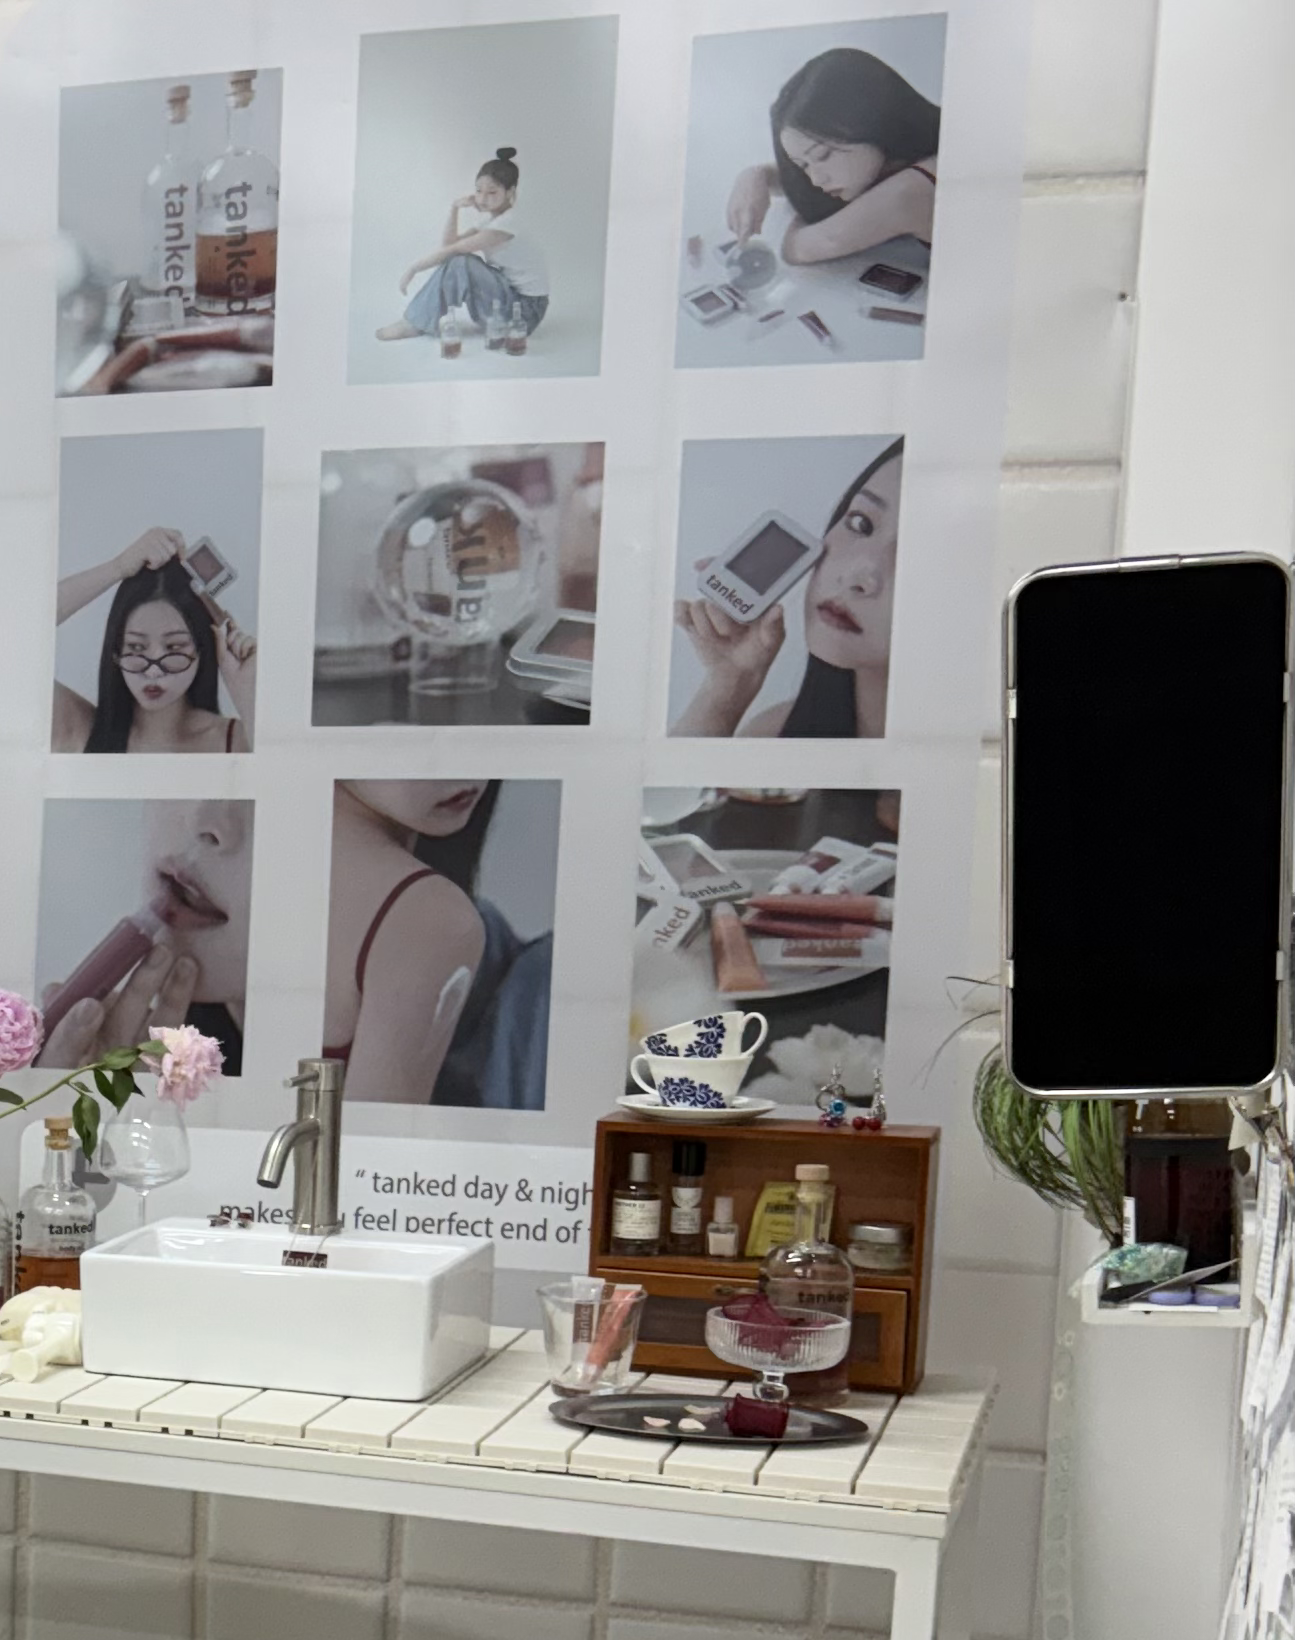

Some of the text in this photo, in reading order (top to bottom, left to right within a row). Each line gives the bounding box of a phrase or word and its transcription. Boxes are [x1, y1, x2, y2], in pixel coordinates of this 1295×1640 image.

[224, 182, 257, 316] tanked
[209, 574, 234, 596] tanked
[706, 573, 754, 617] tanked
[684, 880, 742, 900] anked
[372, 1170, 595, 1212] tanked day & nigh
[48, 1222, 95, 1235] tanked
[354, 1206, 398, 1232] feel
[405, 1210, 493, 1238] perfect
[500, 1218, 548, 1242] end
[556, 1218, 583, 1244] of
